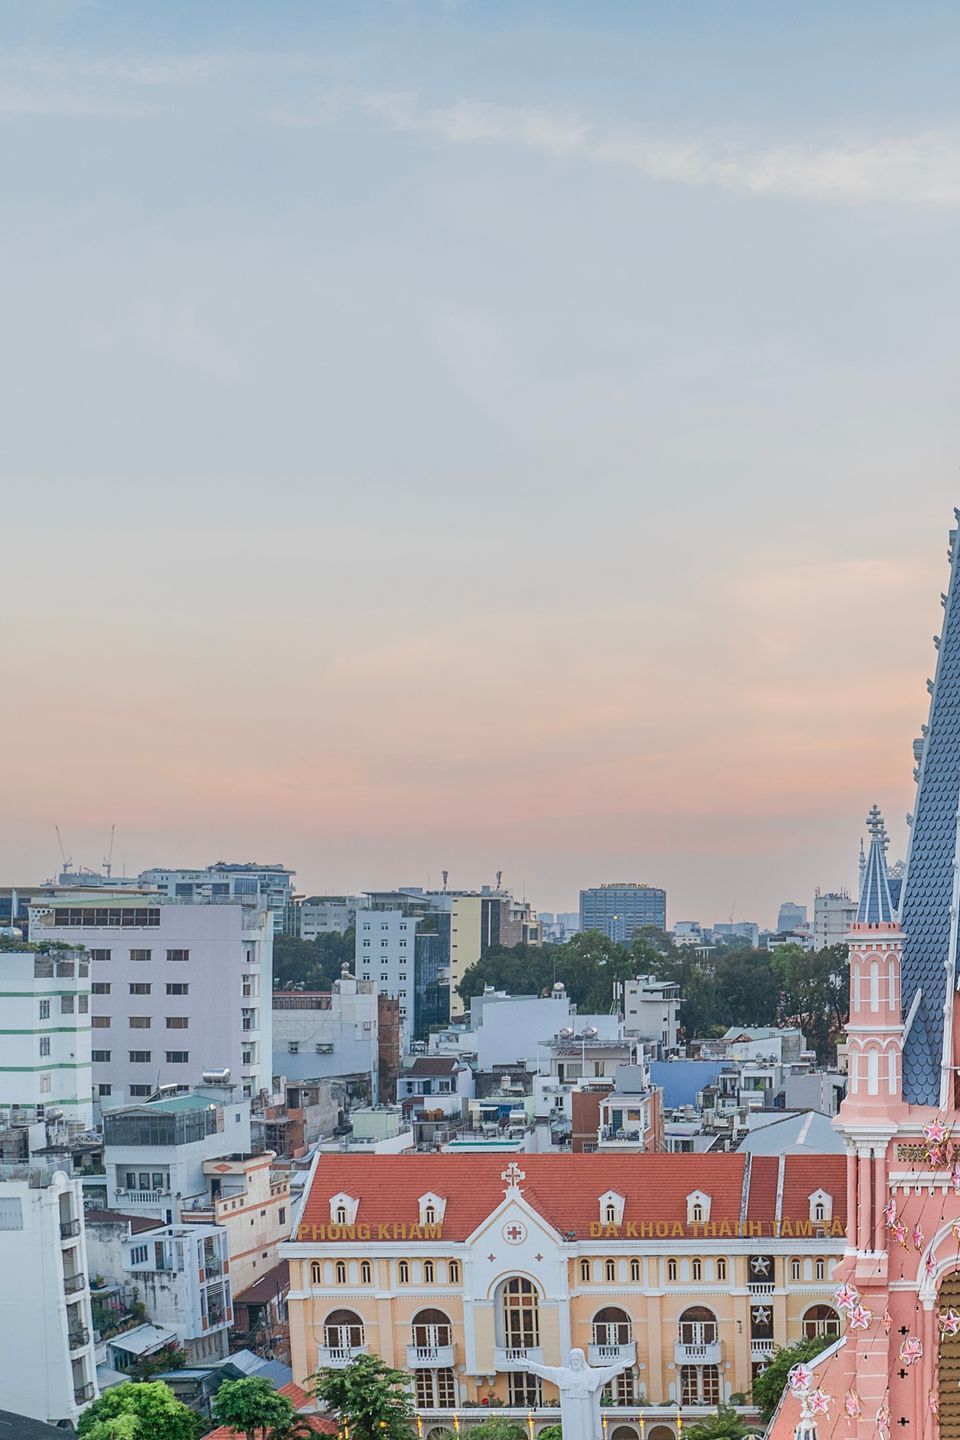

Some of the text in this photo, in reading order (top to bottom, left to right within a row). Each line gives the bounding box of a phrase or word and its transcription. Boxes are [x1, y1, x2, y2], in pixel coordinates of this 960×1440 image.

[298, 1220, 371, 1240] PHÒNG
[626, 1220, 685, 1237] KHOA
[691, 1216, 762, 1237] THÁNH
[770, 1215, 813, 1236] TÂM
